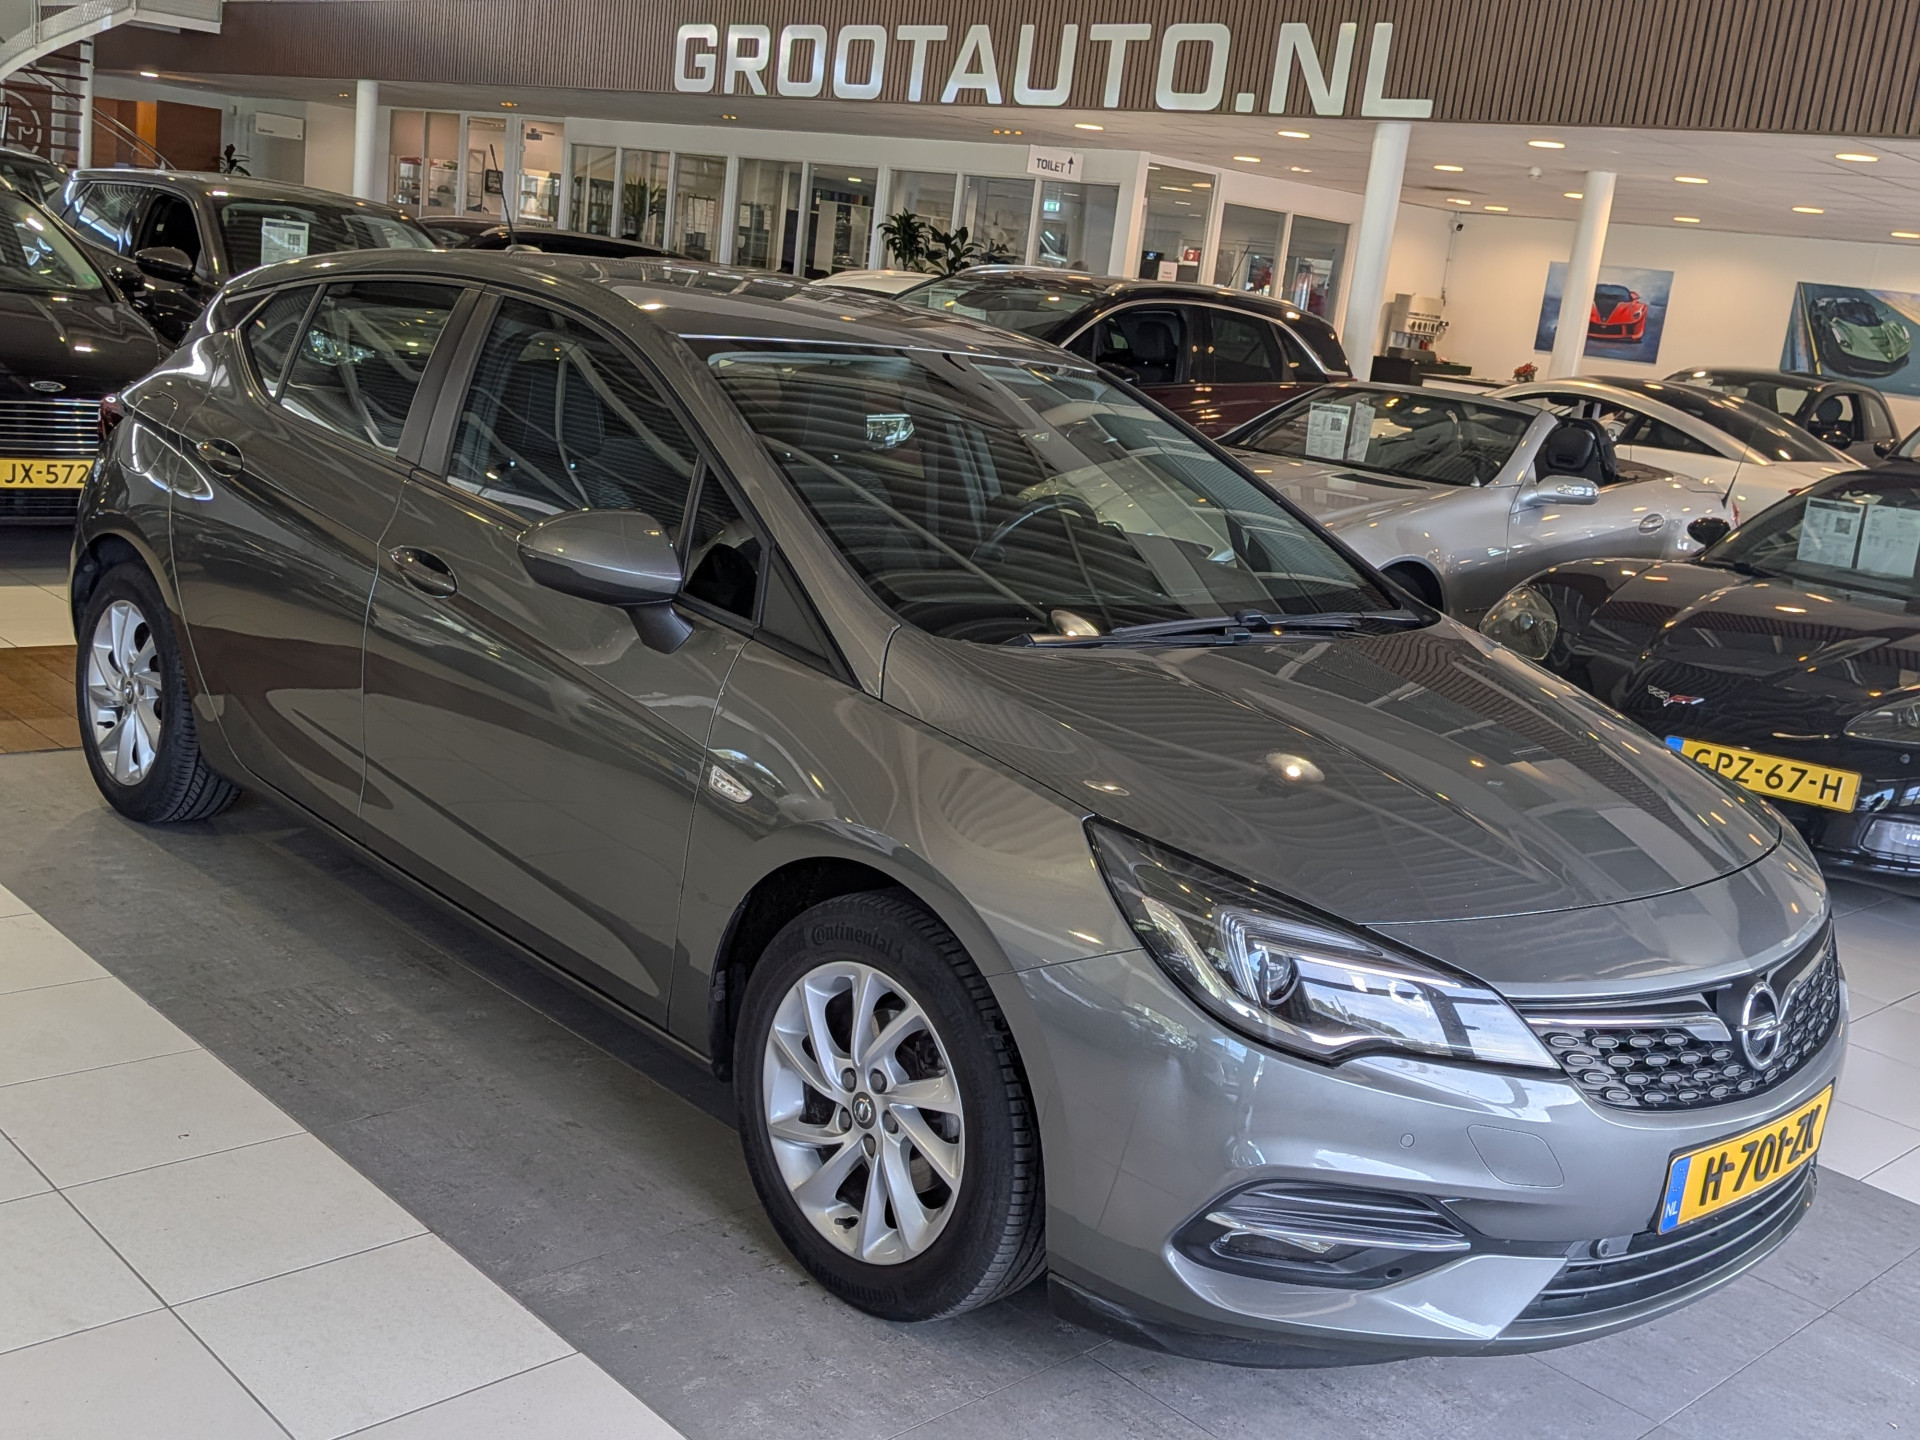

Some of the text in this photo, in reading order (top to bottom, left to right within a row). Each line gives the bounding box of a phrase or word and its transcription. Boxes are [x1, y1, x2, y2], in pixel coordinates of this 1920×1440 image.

[674, 22, 1434, 118] GROOTAUTO.NL
[1036, 158, 1065, 173] TOILET
[810, 922, 894, 957] Continental
[1699, 1104, 1822, 1206] H-701-ZK
[1664, 1201, 1678, 1218] NL
